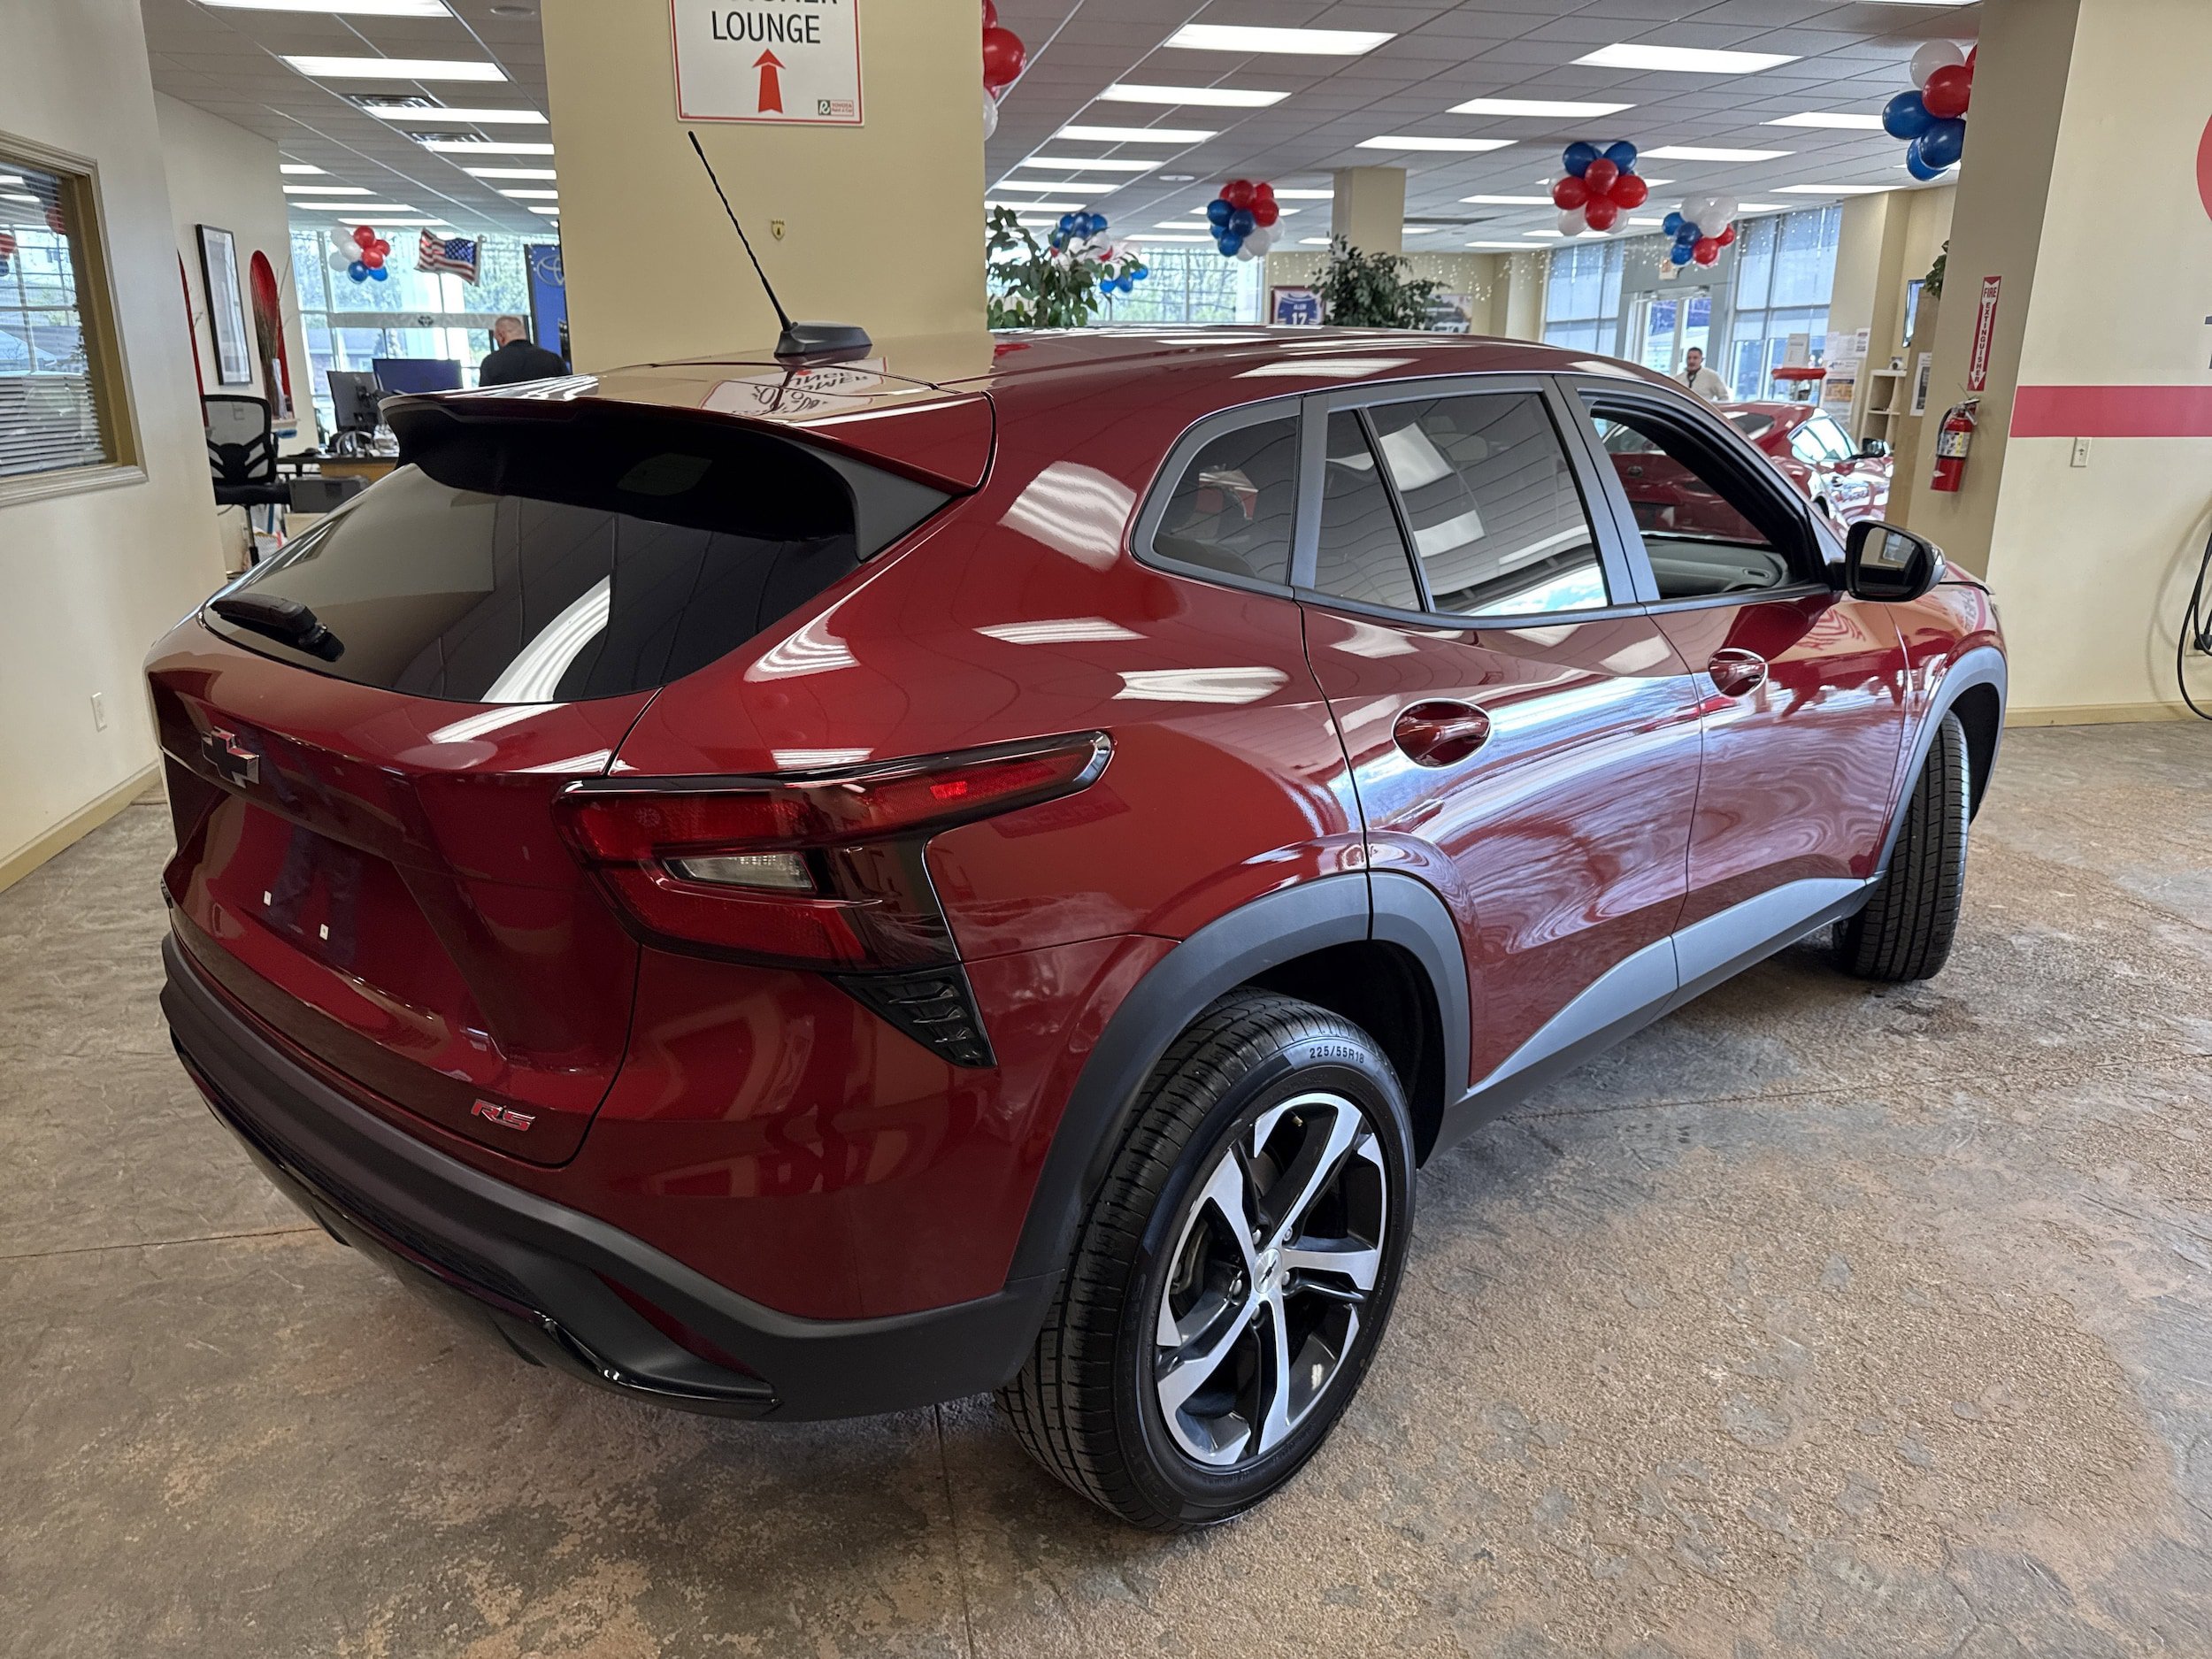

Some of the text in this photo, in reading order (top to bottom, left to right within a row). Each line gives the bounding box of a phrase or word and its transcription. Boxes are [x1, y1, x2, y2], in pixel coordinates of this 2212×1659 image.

[711, 11, 821, 44] LOUNGE
[1983, 287, 1997, 298] FIRE
[1292, 312, 1308, 325] 17
[1974, 302, 1991, 383] EXTINGUISHER
[1310, 1045, 1364, 1064] 225/55R18
[471, 1098, 536, 1132] RS
